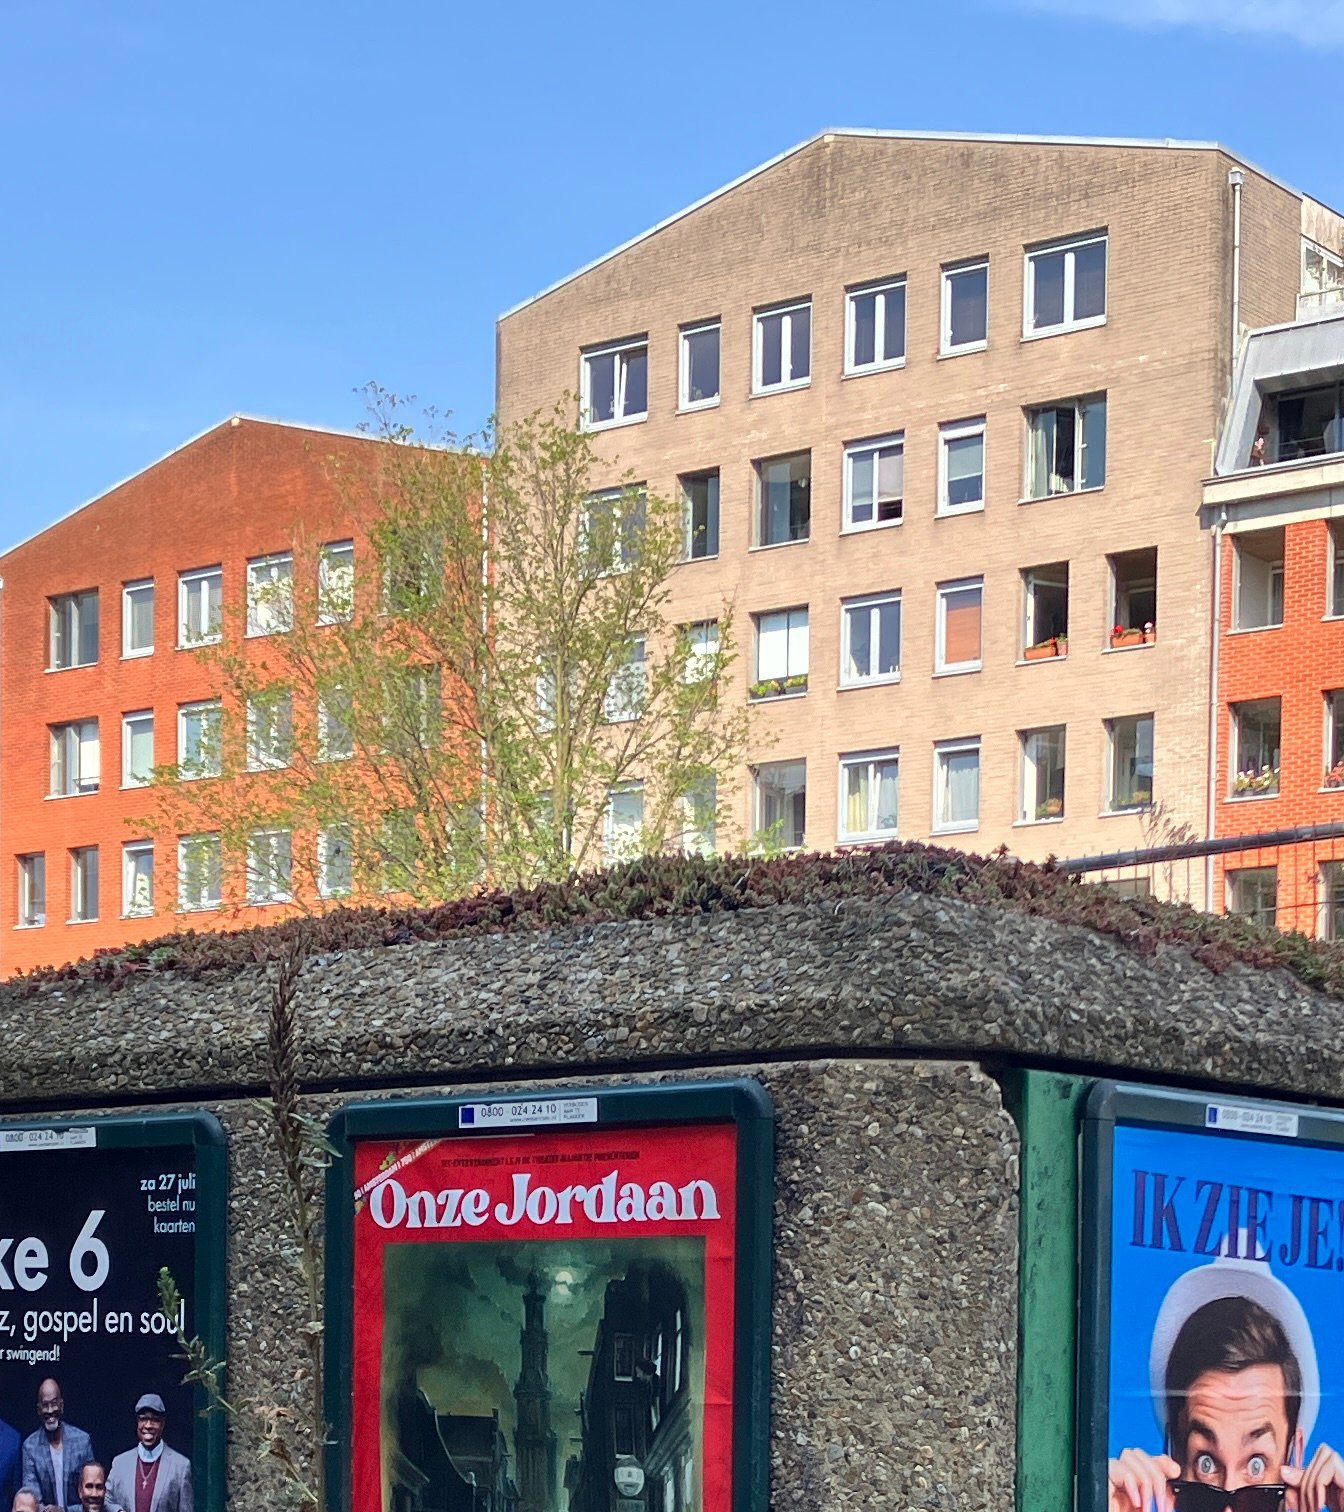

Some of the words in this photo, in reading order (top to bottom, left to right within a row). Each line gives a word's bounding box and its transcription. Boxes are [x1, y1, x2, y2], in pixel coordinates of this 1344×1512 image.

[481, 1106, 504, 1117] 0800
[511, 1105, 528, 1116] 024
[531, 1104, 543, 1115] 24
[546, 1103, 557, 1114] 10
[140, 1180, 156, 1190] za
[158, 1174, 176, 1190] 27
[177, 1172, 196, 1194] juli
[147, 1194, 180, 1211] bestel
[182, 1200, 196, 1211] nu
[369, 1178, 489, 1229] Onze
[495, 1170, 721, 1224] Jordaan
[153, 1215, 196, 1233] kaarten
[1129, 1168, 1187, 1253] IK
[1192, 1179, 1273, 1263] ZIE
[69, 1209, 110, 1291] 6
[24, 1298, 98, 1342] gospel
[105, 1311, 133, 1333] en
[139, 1298, 185, 1334] soul
[6, 1345, 60, 1364] swingend!
